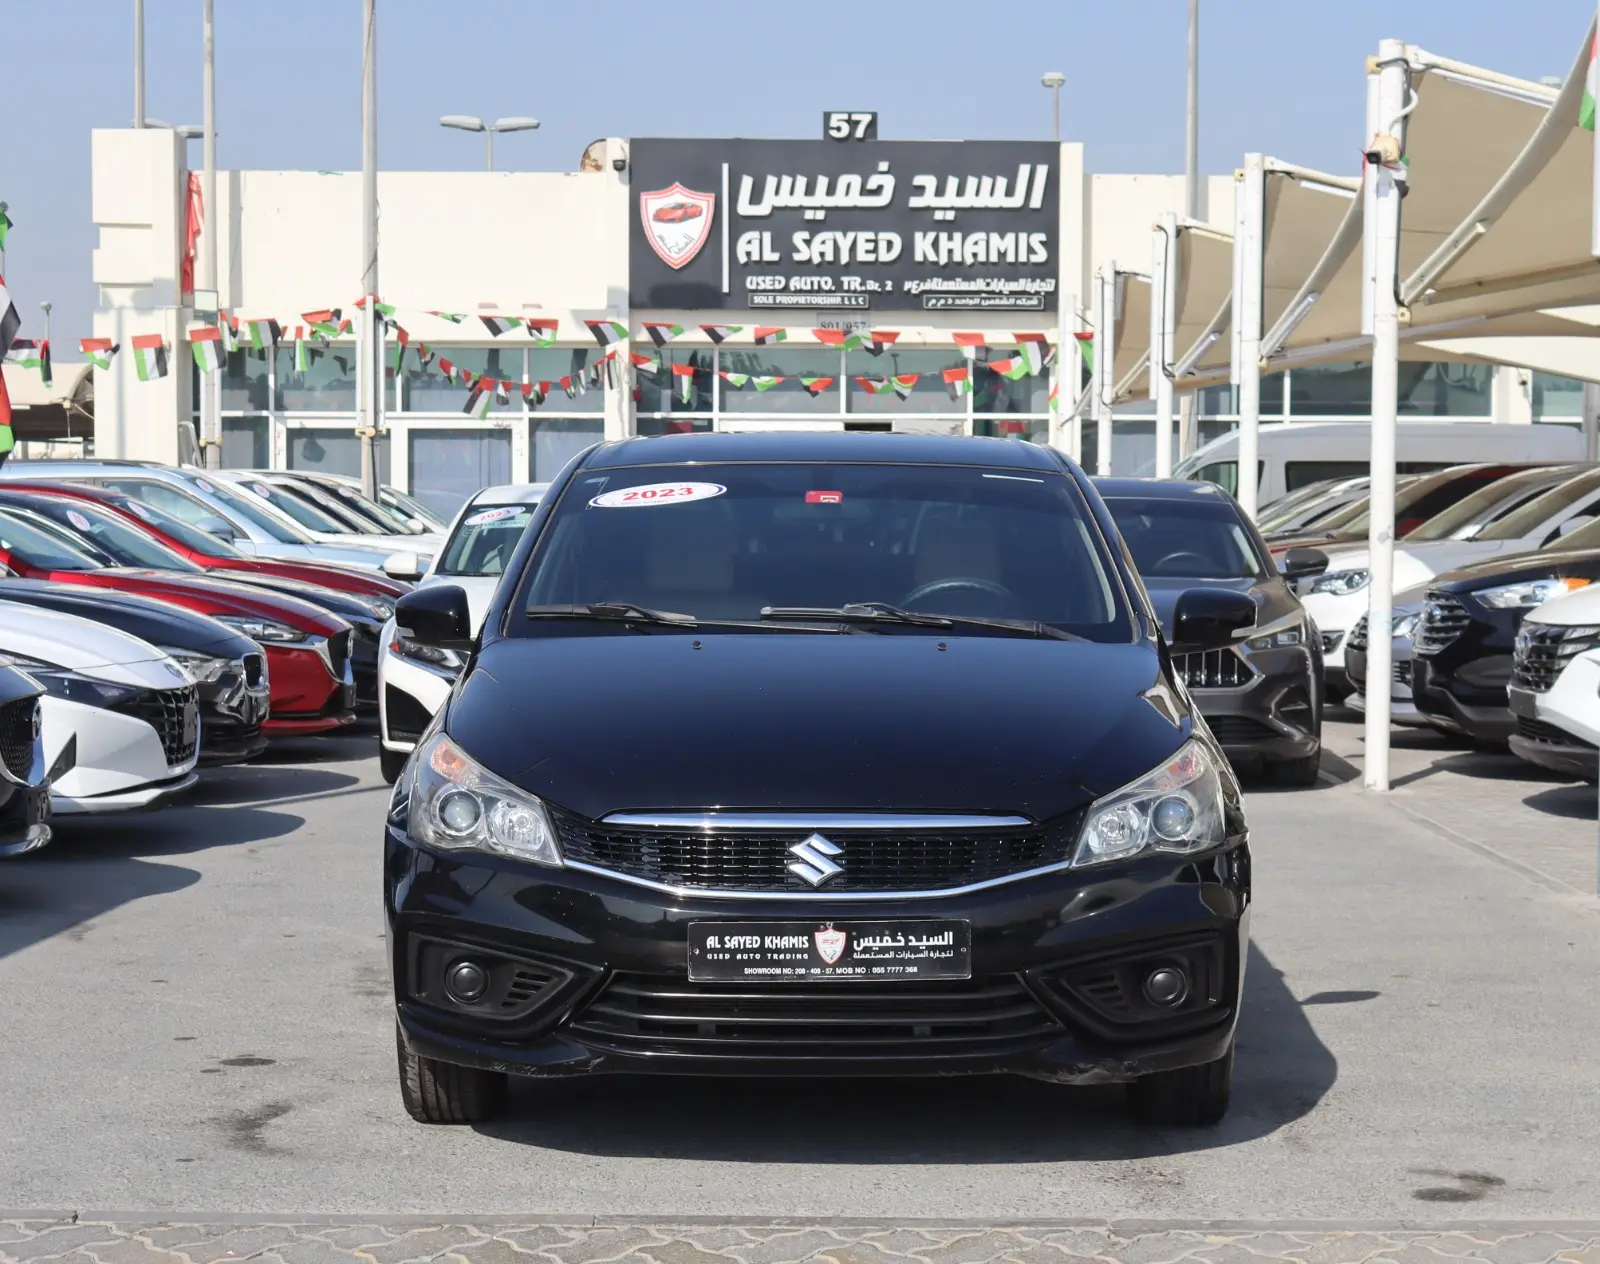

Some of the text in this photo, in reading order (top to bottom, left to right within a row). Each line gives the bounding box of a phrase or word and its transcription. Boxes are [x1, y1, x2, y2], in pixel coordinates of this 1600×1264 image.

[828, 113, 873, 139] 57
[736, 161, 1049, 221] السيد خميس
[736, 231, 1048, 265] AL SAYED KHAMIS
[745, 275, 786, 291] USED
[753, 295, 774, 304] SOLE
[623, 487, 694, 501] 2023
[706, 936, 809, 949] AL SAYED KHAMIS
[853, 931, 953, 951] السيد خميس
[853, 949, 954, 959] لتجارة السيارات المستعملة
[744, 967, 782, 975] SHOWROOM
[836, 967, 853, 975] MOB
